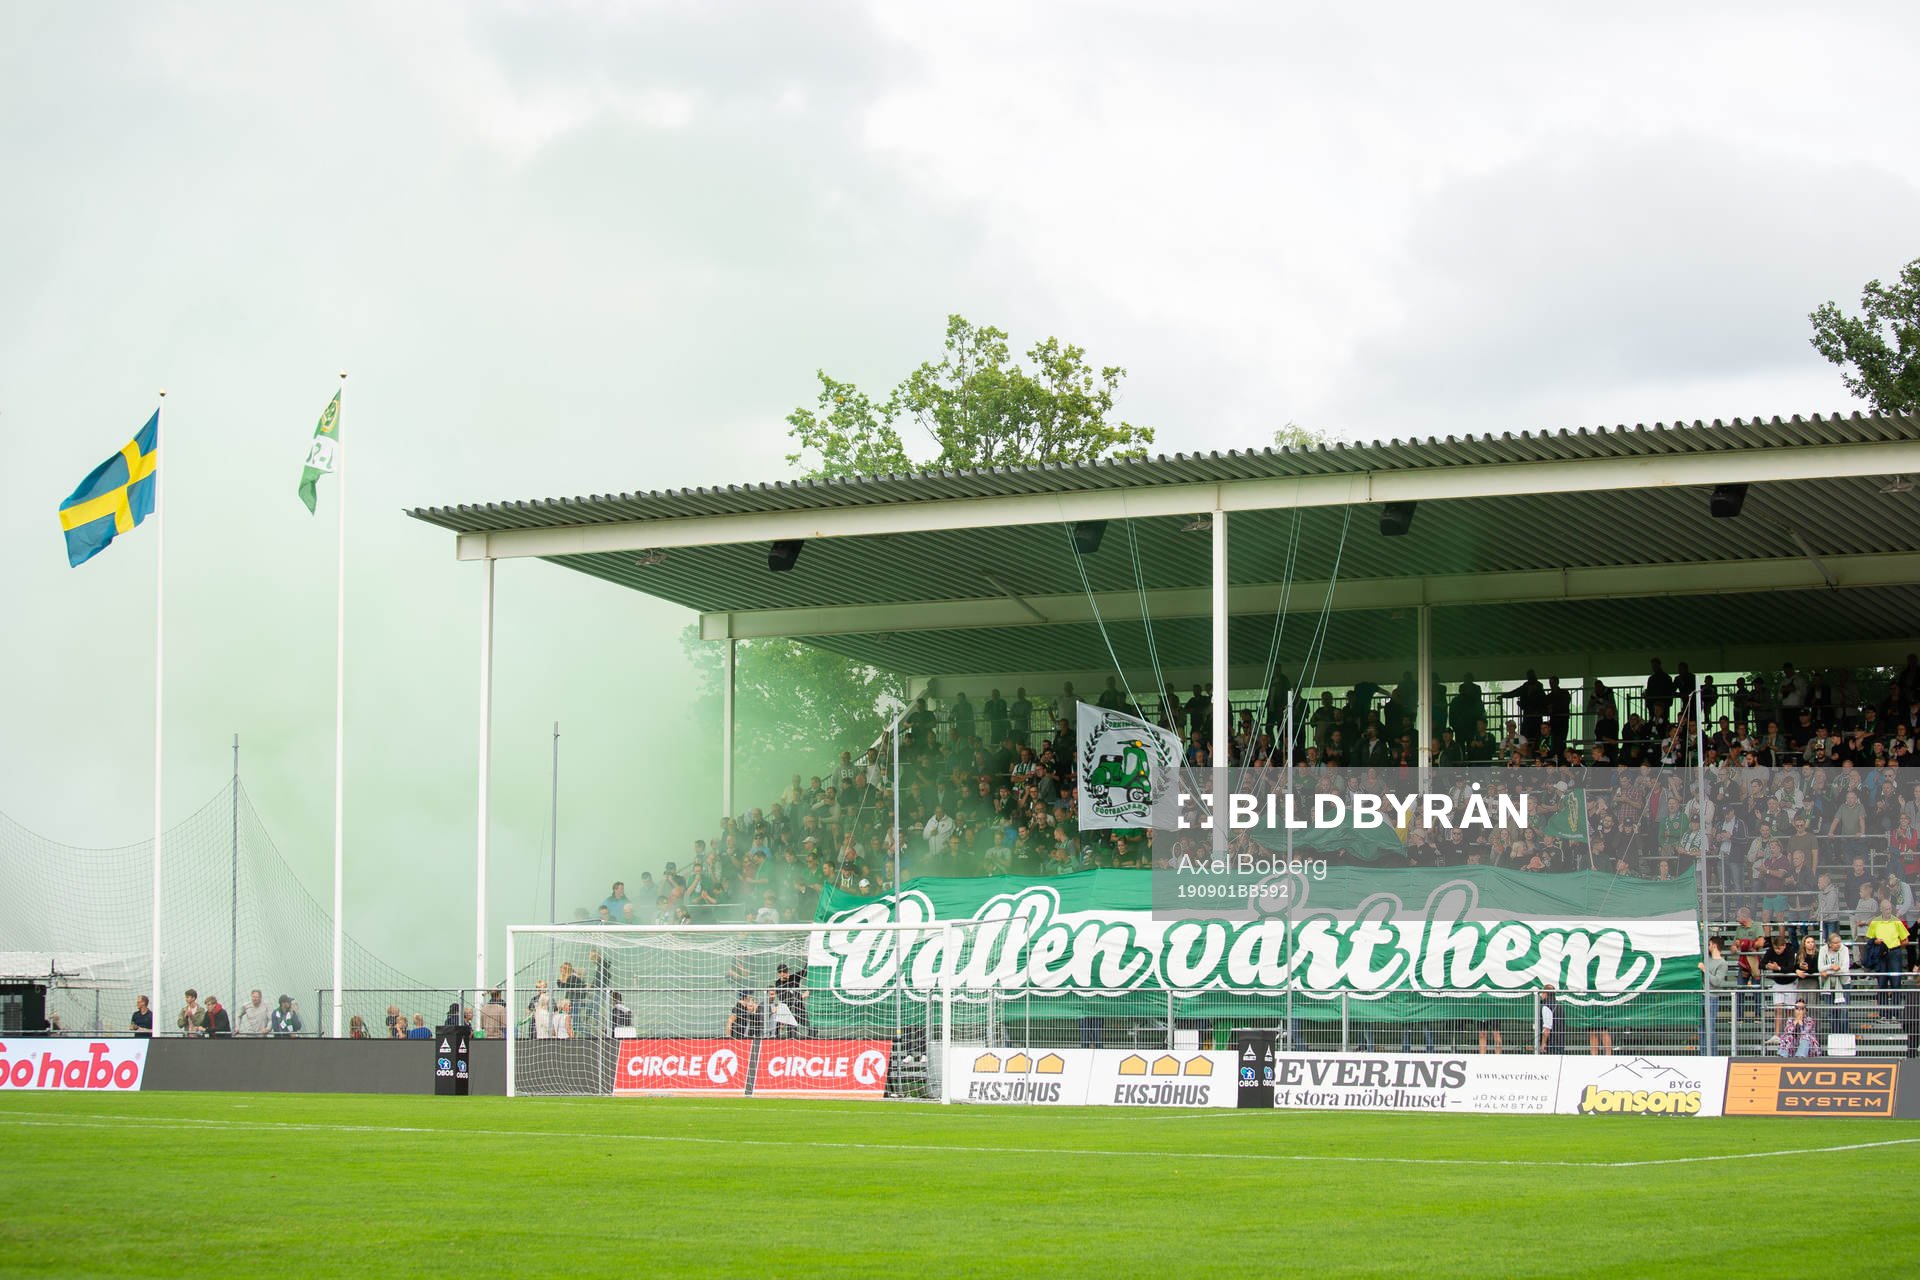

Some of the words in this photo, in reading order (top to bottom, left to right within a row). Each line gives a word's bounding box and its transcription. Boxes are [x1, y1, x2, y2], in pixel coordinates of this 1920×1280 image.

[1164, 876, 1404, 992] vårt
[1420, 886, 1650, 998] hem
[37, 1043, 139, 1088] habo
[627, 1056, 703, 1077] CIRCLE
[713, 1053, 736, 1082] K
[768, 1057, 849, 1078] CIRCLE
[859, 1054, 883, 1083] K
[1275, 1059, 1467, 1089] EVERINS
[1476, 1072, 1550, 1081] www.severins.se
[968, 1078, 1061, 1102] EKSJÖHUS
[1669, 1081, 1701, 1089] BYGG
[1786, 1072, 1886, 1086] WORK
[1114, 1081, 1210, 1105] EKSJÖHUS
[1295, 1090, 1340, 1106] stora
[1344, 1091, 1447, 1108] möbelhuset
[1580, 1085, 1701, 1113] Jonsons
[1784, 1097, 1880, 1107] SYSTEM
